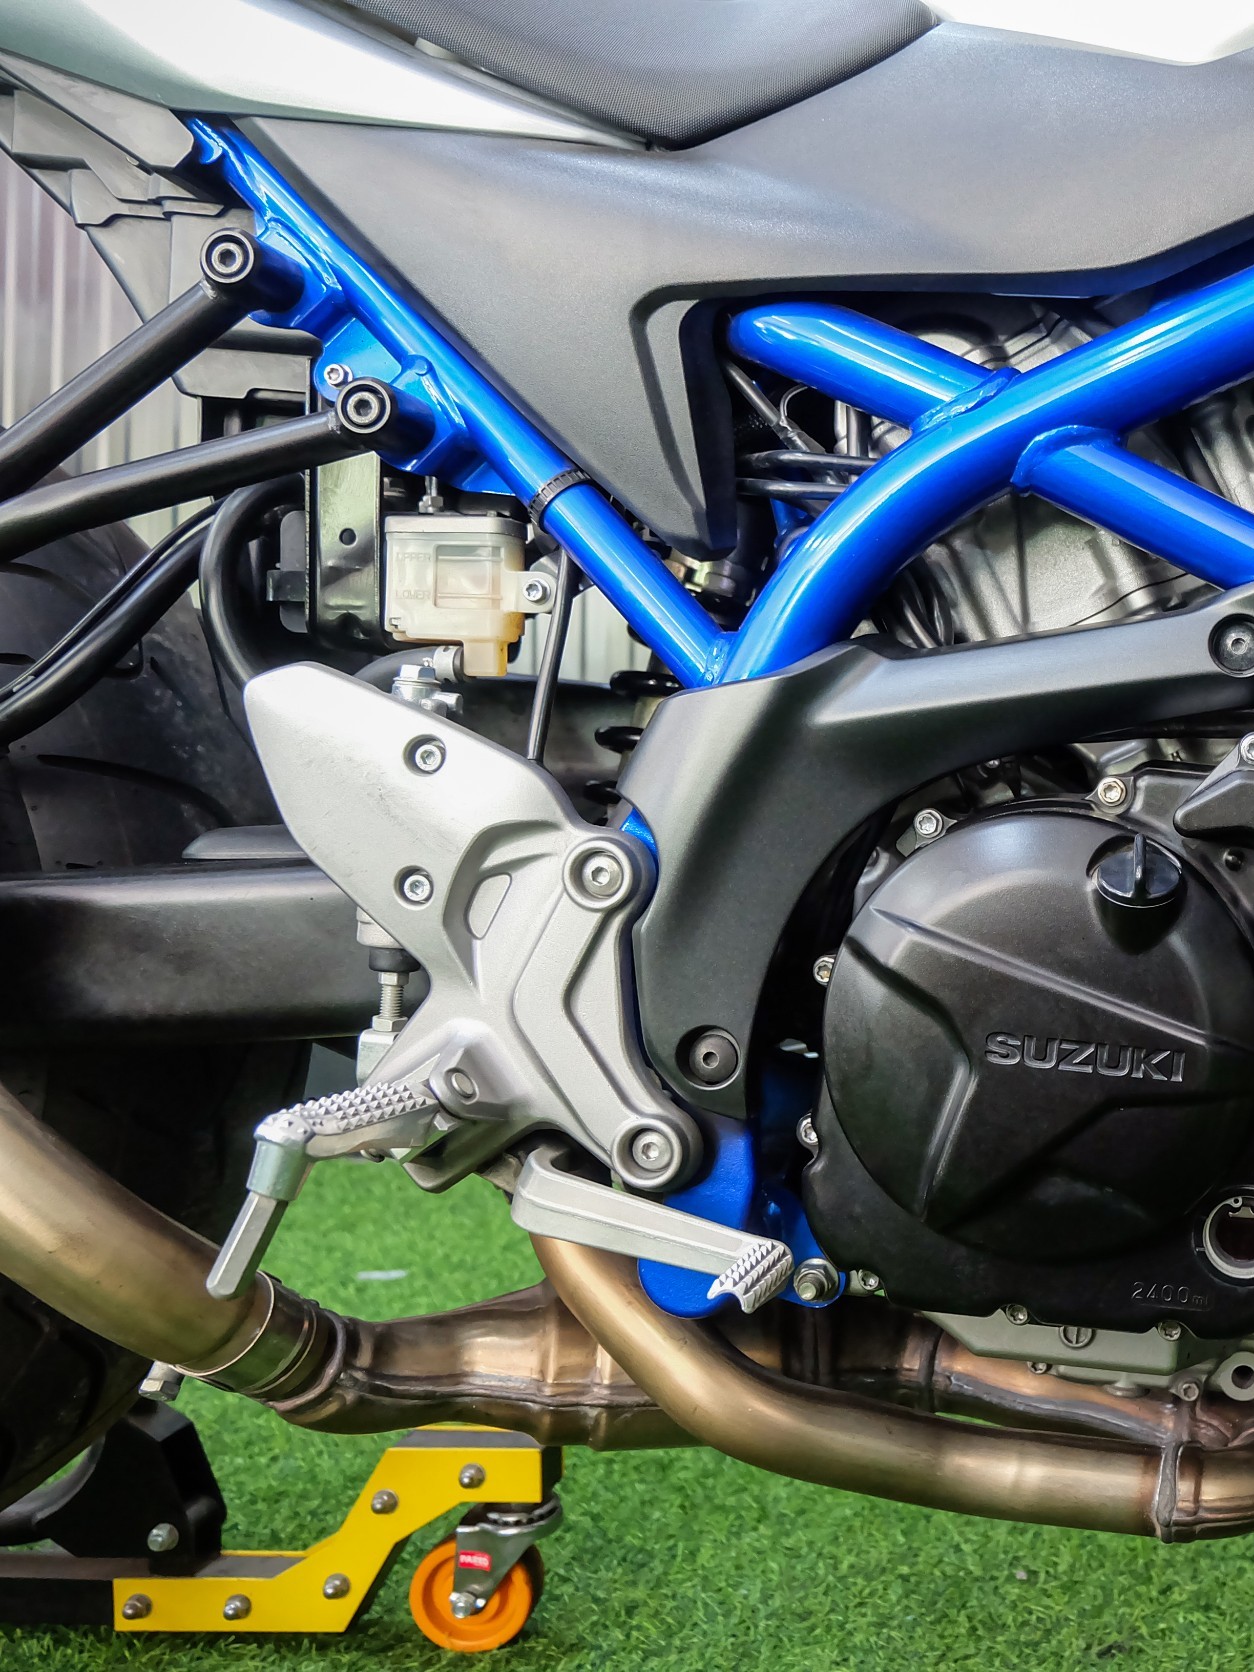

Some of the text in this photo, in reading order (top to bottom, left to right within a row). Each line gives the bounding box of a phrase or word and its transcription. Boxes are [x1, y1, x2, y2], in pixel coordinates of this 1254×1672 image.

[395, 552, 431, 562] UPPER
[395, 590, 431, 600] LOWER
[985, 1031, 1186, 1082] SUZUKI
